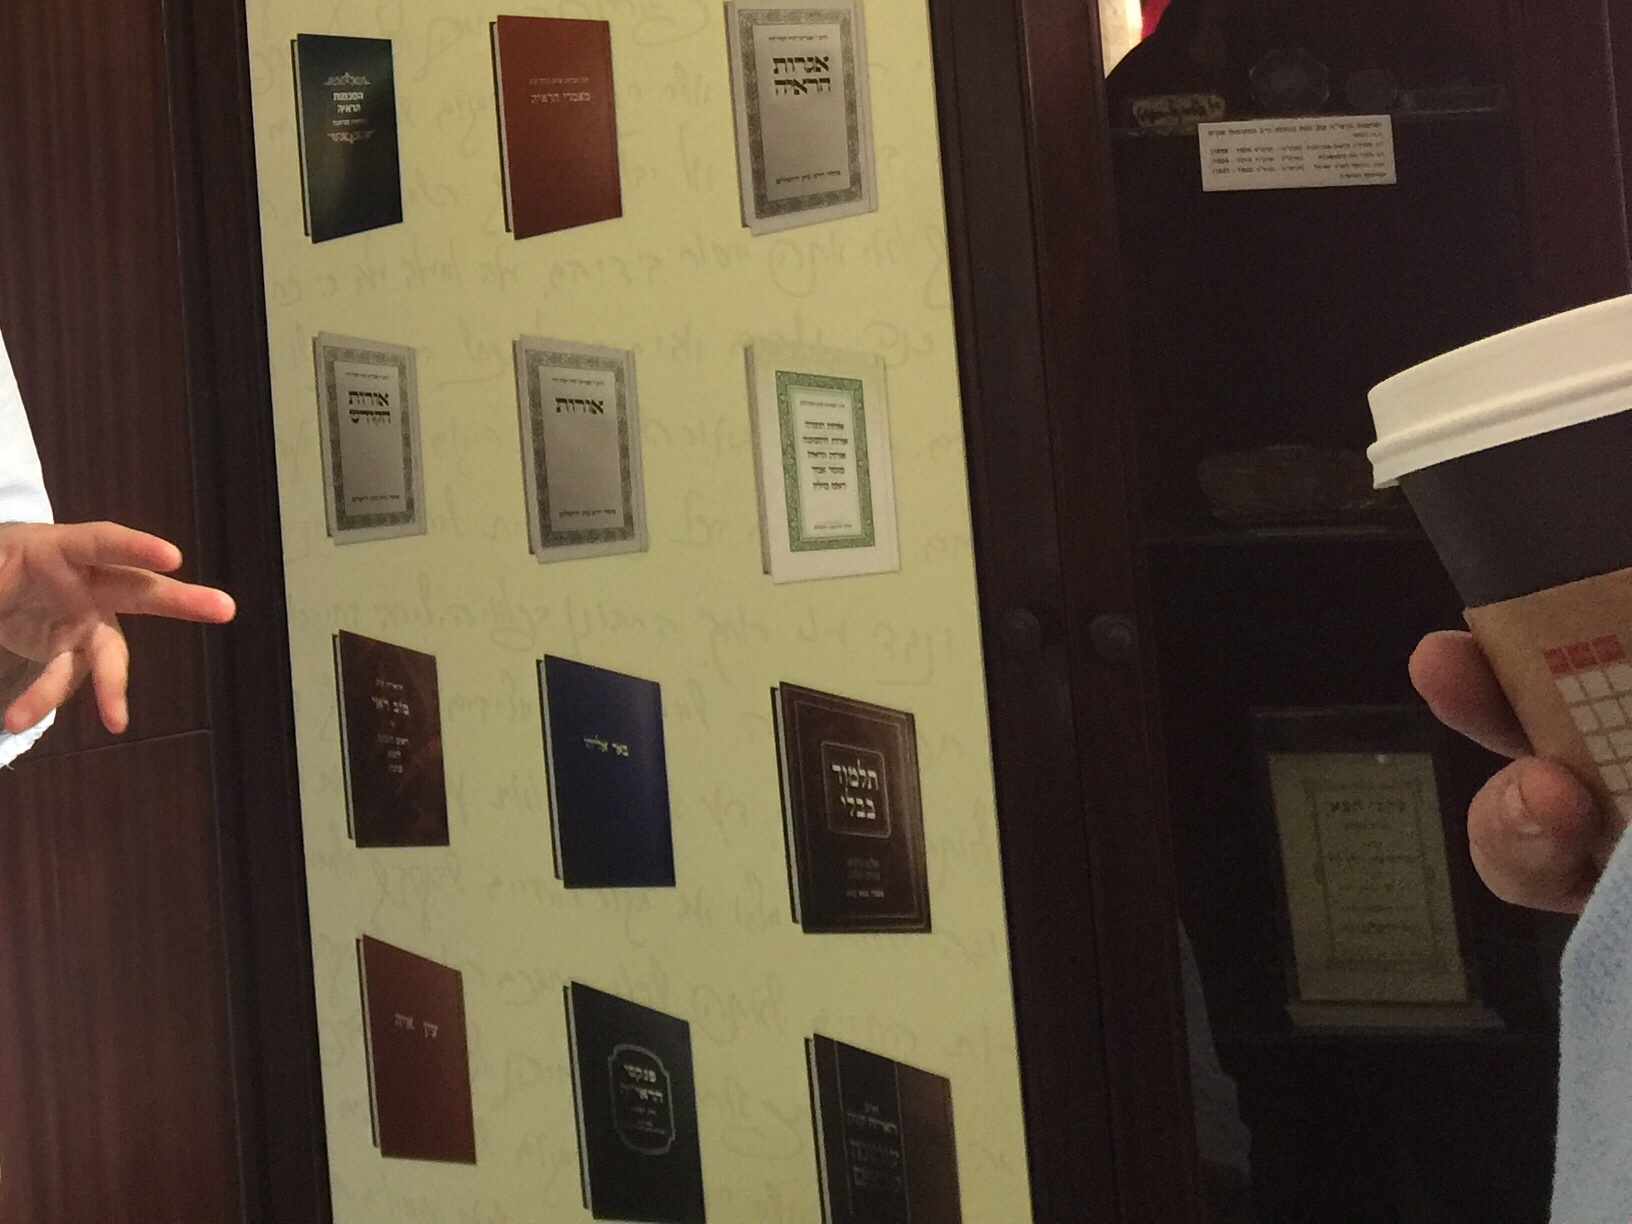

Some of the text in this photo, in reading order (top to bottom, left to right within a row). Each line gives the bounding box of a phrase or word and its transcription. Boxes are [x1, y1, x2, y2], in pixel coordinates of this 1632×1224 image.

[772, 55, 829, 75] אגרות
[347, 390, 390, 407] אורות
[554, 396, 604, 415] אורות
[832, 758, 879, 791] תלמוד
[840, 787, 877, 820] בבלי
